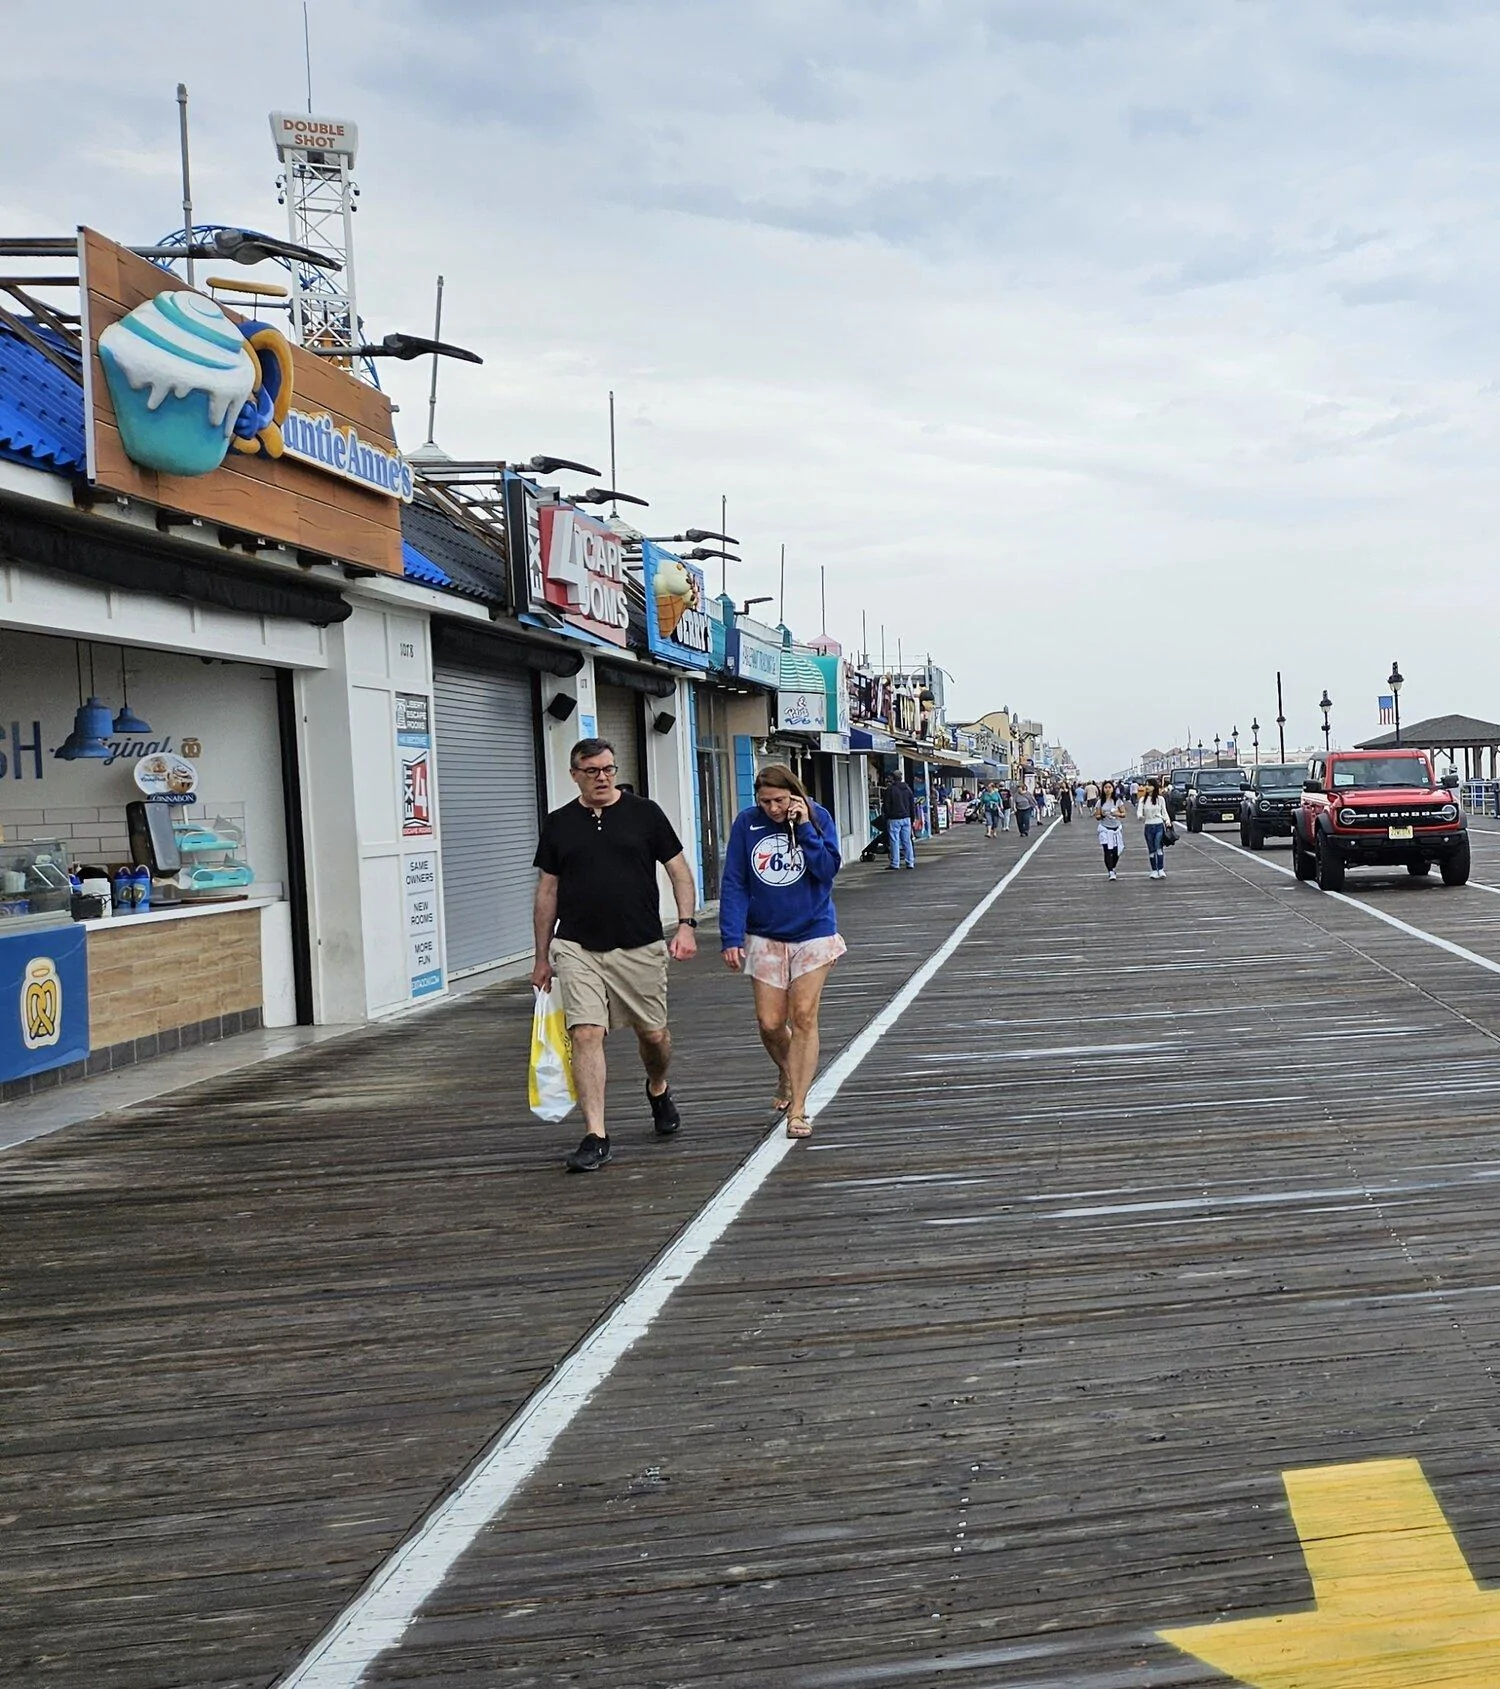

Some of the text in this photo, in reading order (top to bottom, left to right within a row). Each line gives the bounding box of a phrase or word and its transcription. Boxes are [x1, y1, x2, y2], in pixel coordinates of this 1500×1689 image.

[283, 119, 345, 137] DOUBLE
[294, 133, 336, 149] SHOT
[284, 414, 412, 498] untie Anne's
[525, 492, 545, 599] EXIT
[548, 510, 588, 605] 4
[404, 766, 414, 818] EXIT
[415, 766, 427, 817] 4
[410, 860, 429, 872] SAME
[758, 852, 802, 871] 76ers
[405, 872, 434, 885] OWNERS
[413, 902, 429, 912] NEW
[411, 913, 433, 926] ROOMS
[414, 941, 433, 953] MORE
[418, 955, 431, 966] FUN
